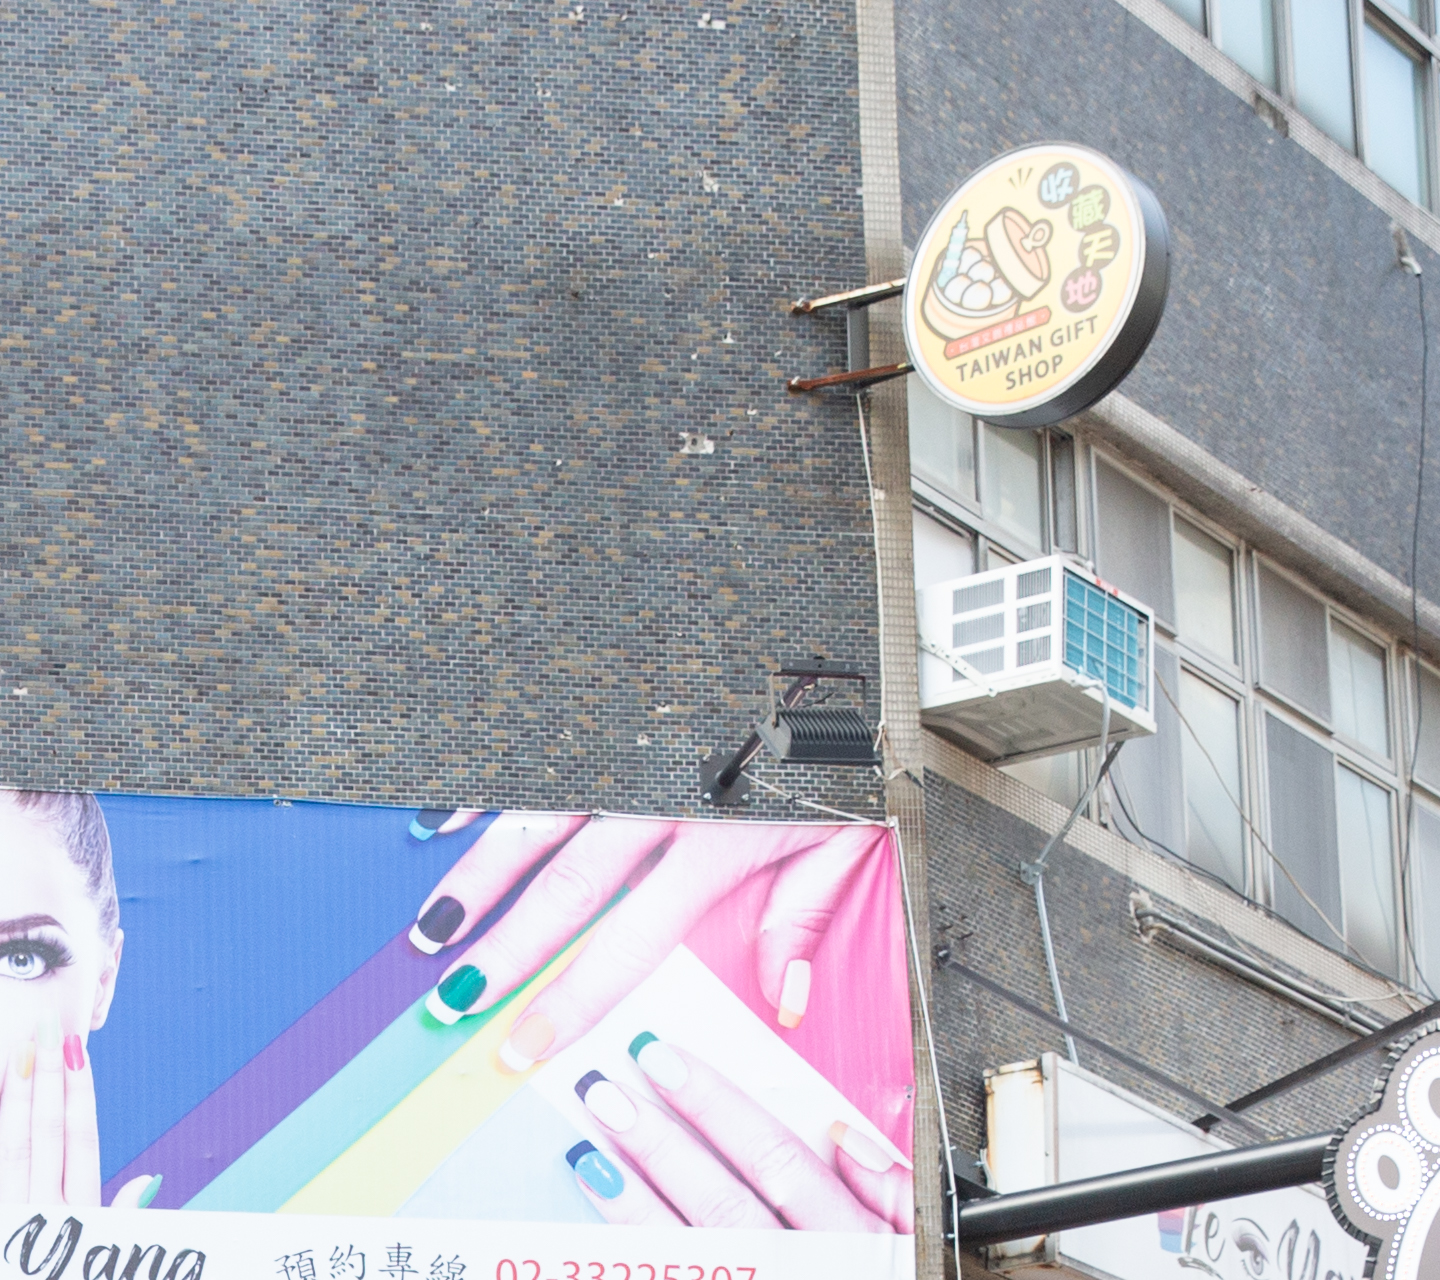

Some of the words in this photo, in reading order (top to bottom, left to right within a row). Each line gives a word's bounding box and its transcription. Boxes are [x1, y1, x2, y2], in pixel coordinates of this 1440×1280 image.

[1039, 167, 1115, 307] 收藏天地
[955, 336, 1043, 383] TAIWAN
[1051, 315, 1099, 349] GIFT
[1005, 354, 1065, 391] SHOP
